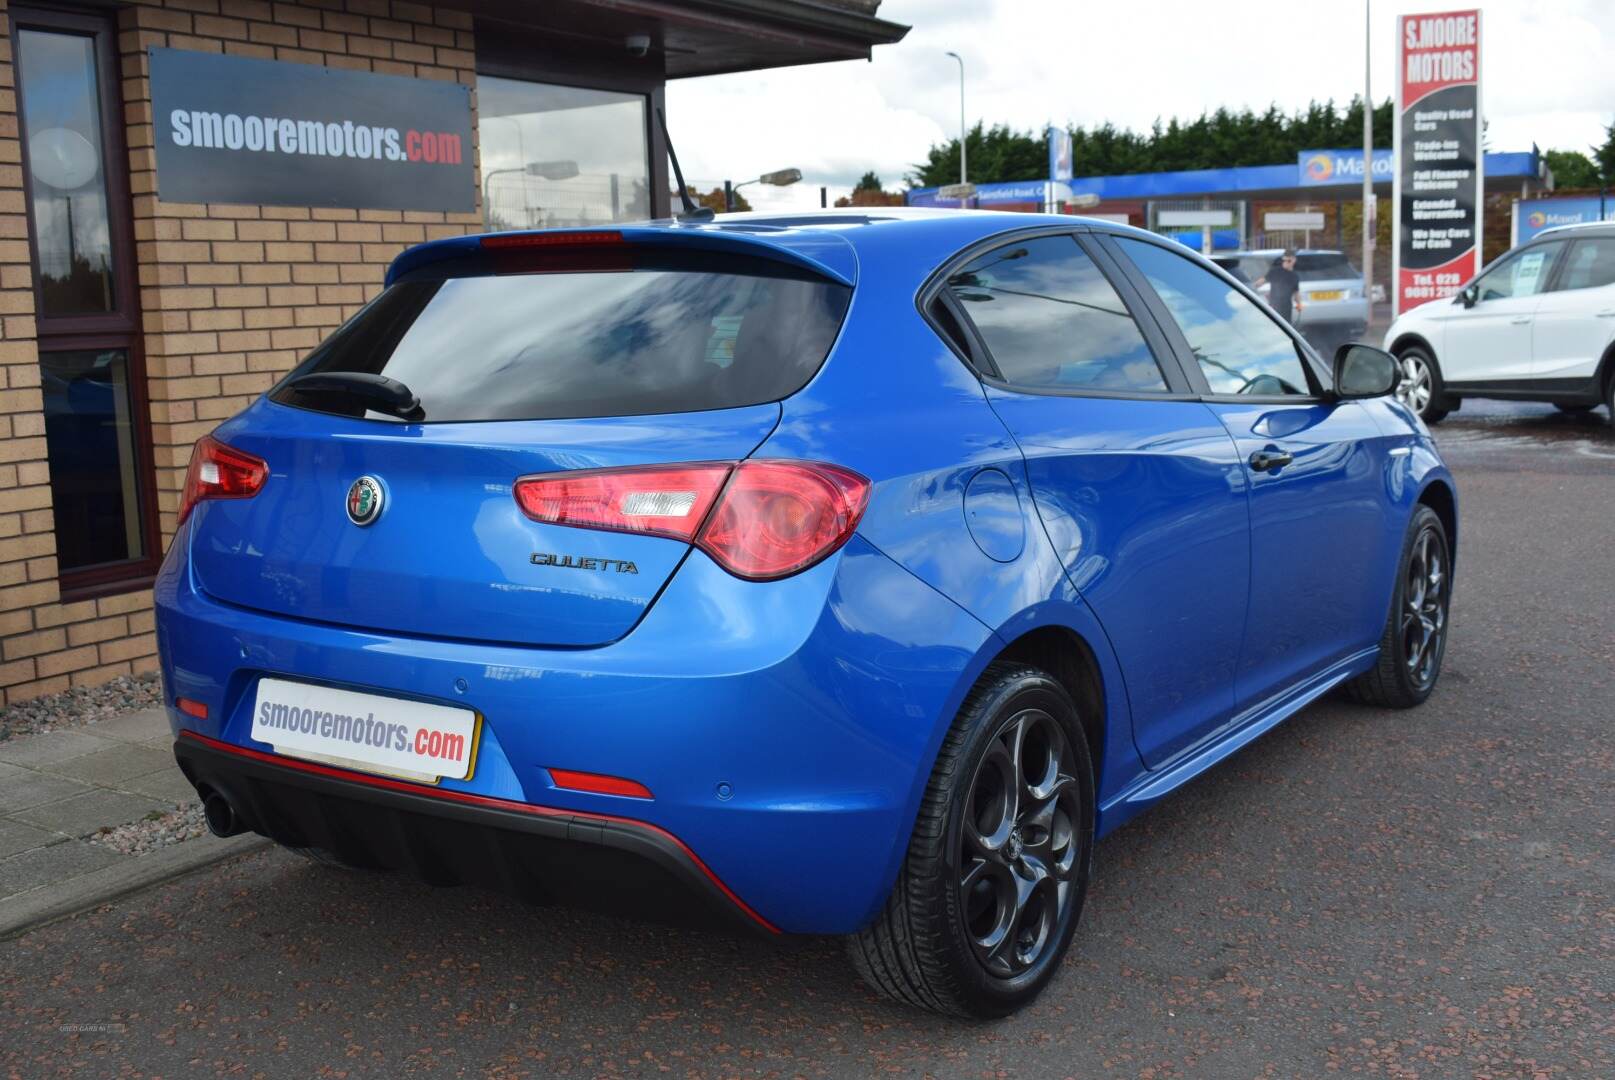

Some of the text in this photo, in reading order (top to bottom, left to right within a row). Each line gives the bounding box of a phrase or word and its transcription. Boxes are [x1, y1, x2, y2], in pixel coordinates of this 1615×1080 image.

[1405, 15, 1476, 50] S.MOORE
[1406, 49, 1474, 84] MOTORS
[170, 109, 462, 164] smooremotors.com
[529, 552, 639, 575] GIULIETTA
[258, 700, 465, 762] smooremotors.com
